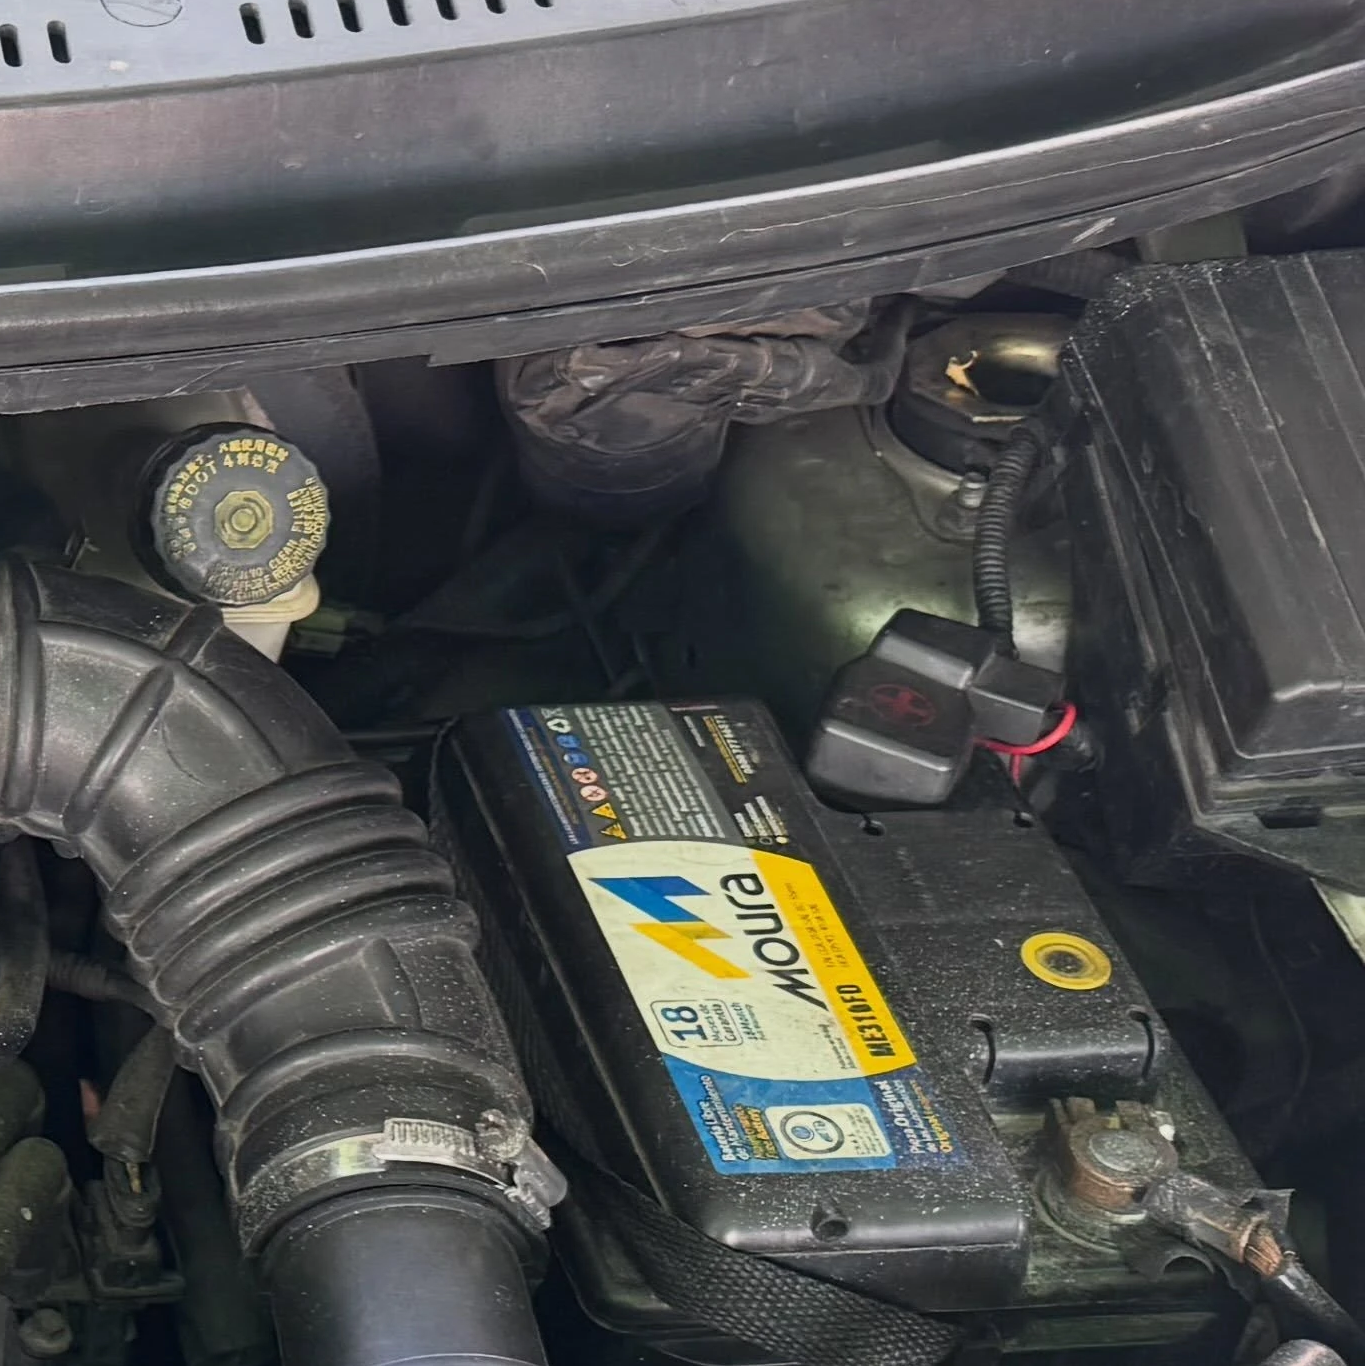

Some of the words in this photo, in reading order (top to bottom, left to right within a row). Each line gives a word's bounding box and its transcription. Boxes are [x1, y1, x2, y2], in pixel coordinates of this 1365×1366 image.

[660, 1005, 708, 1041] 18
[701, 1015, 724, 1042] Meses
[873, 1080, 914, 1127] Original
